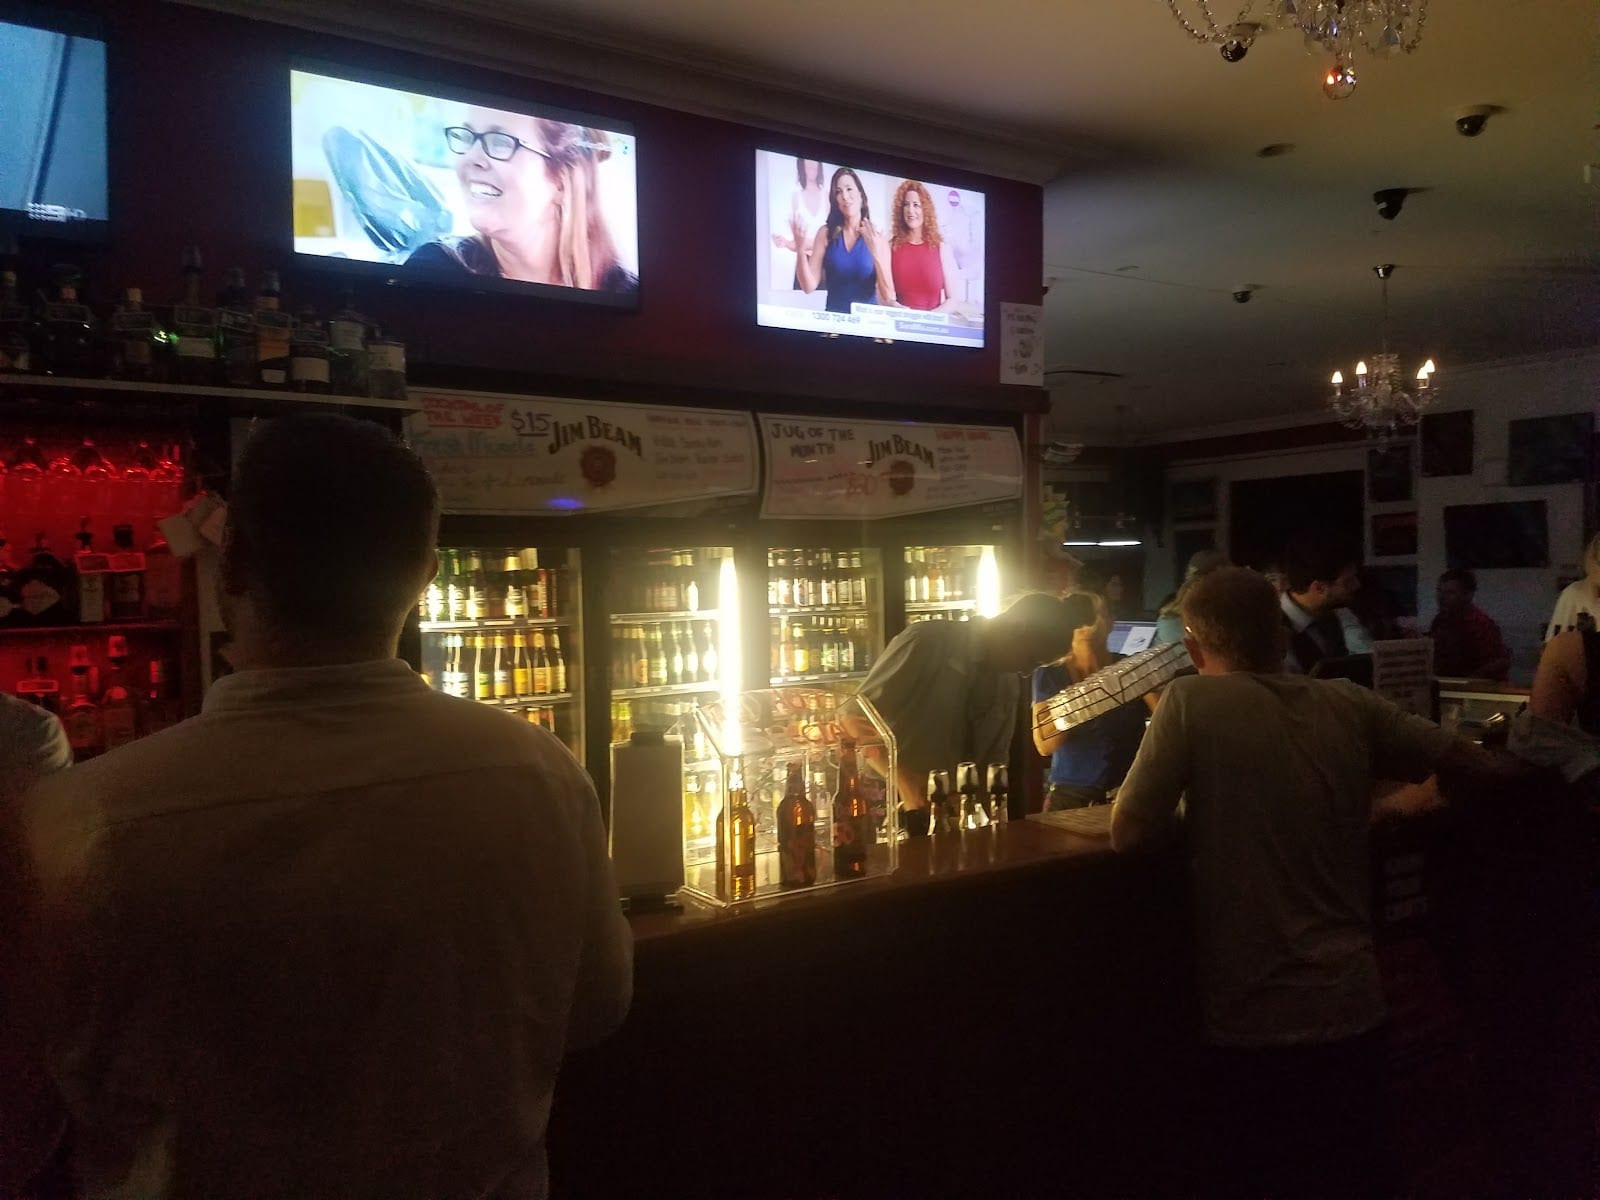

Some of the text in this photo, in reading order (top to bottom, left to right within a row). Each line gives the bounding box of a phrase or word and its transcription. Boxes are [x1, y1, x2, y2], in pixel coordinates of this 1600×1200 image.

[511, 408, 552, 433] $15
[771, 423, 856, 441] JUG OF THE
[548, 420, 586, 455] JIM
[586, 415, 644, 457] BEAM
[790, 442, 836, 458] MONTH
[865, 439, 893, 469] JIM
[892, 434, 936, 469] BEAM
